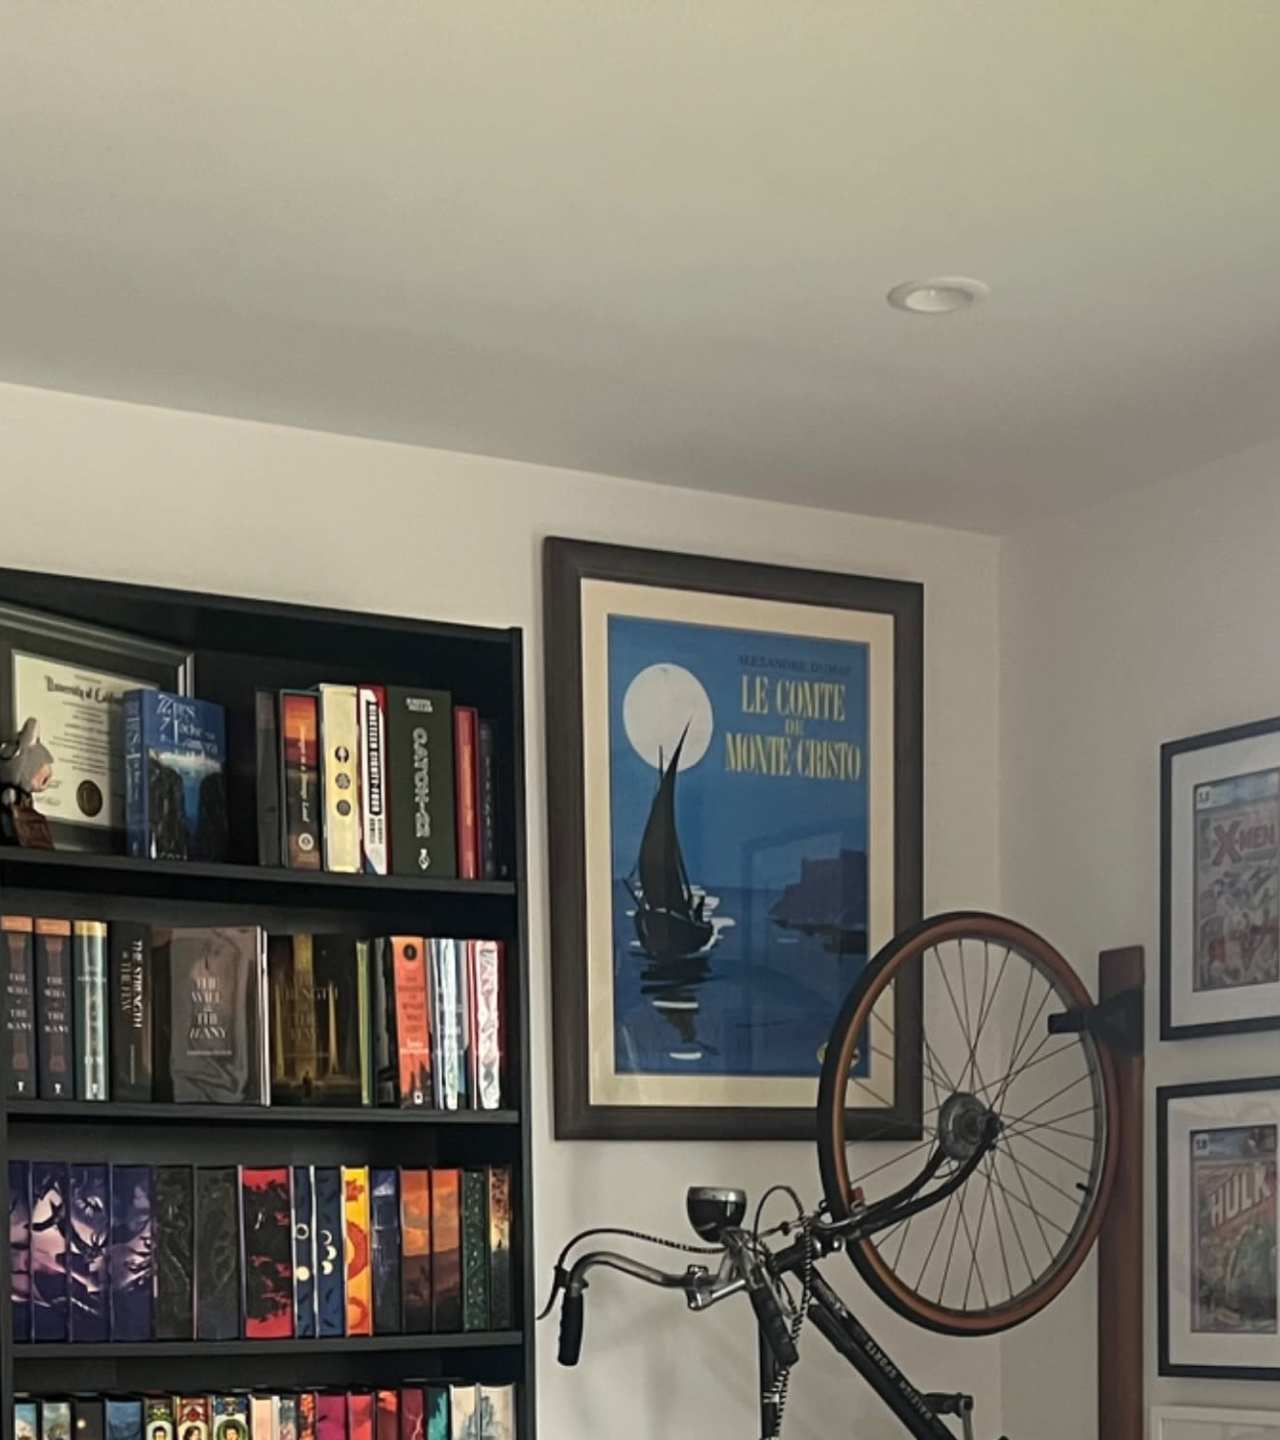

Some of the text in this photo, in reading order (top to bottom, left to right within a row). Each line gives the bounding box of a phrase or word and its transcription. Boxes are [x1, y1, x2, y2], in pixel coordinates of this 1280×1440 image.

[741, 674, 846, 721] LE COMTE
[726, 733, 862, 783] MONTE CRISTO
[1212, 820, 1276, 866] X-MEN
[133, 966, 143, 1028] STRENGTH
[1210, 1163, 1271, 1227] HULK
